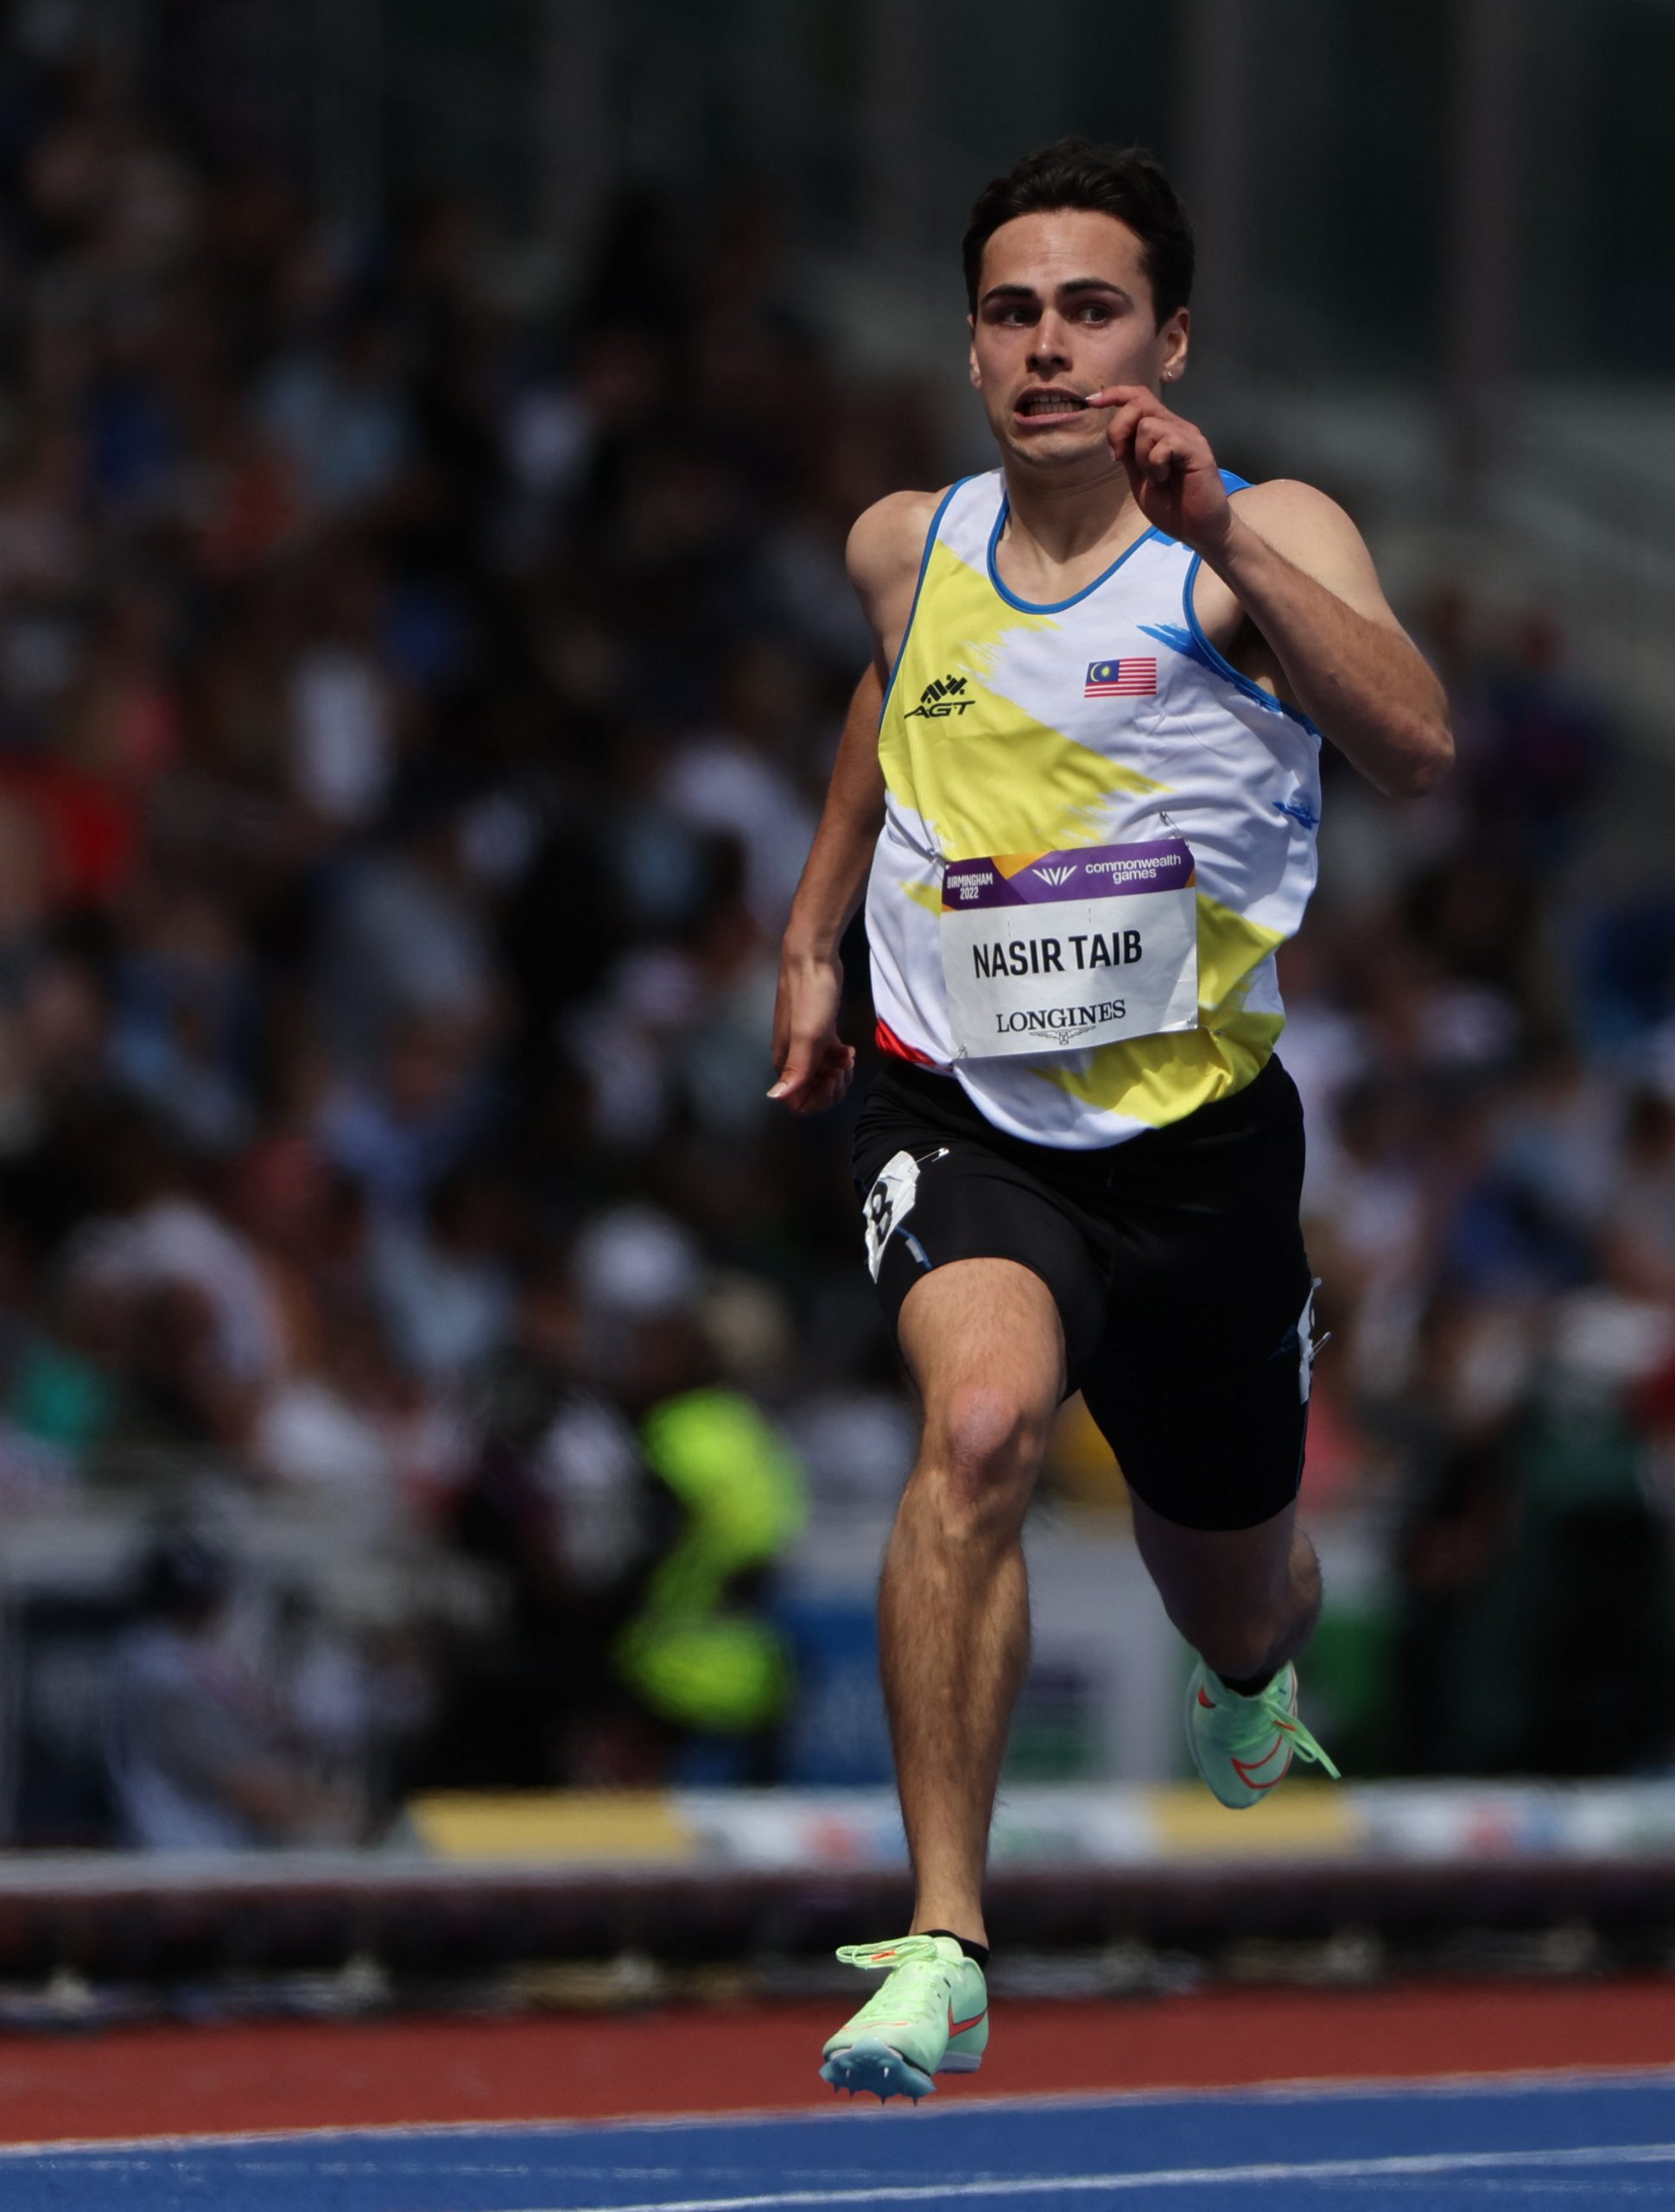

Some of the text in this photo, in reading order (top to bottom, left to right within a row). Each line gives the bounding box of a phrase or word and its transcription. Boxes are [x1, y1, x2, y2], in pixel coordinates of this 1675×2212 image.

[904, 700, 975, 720] AGT
[1085, 855, 1182, 875] commonwealth
[947, 872, 993, 889] BIRMINGHAM
[1113, 868, 1157, 885] games
[960, 886, 979, 900] 2022
[972, 929, 1144, 979] NASIR TAIB
[996, 999, 1126, 1033] LONGINES
